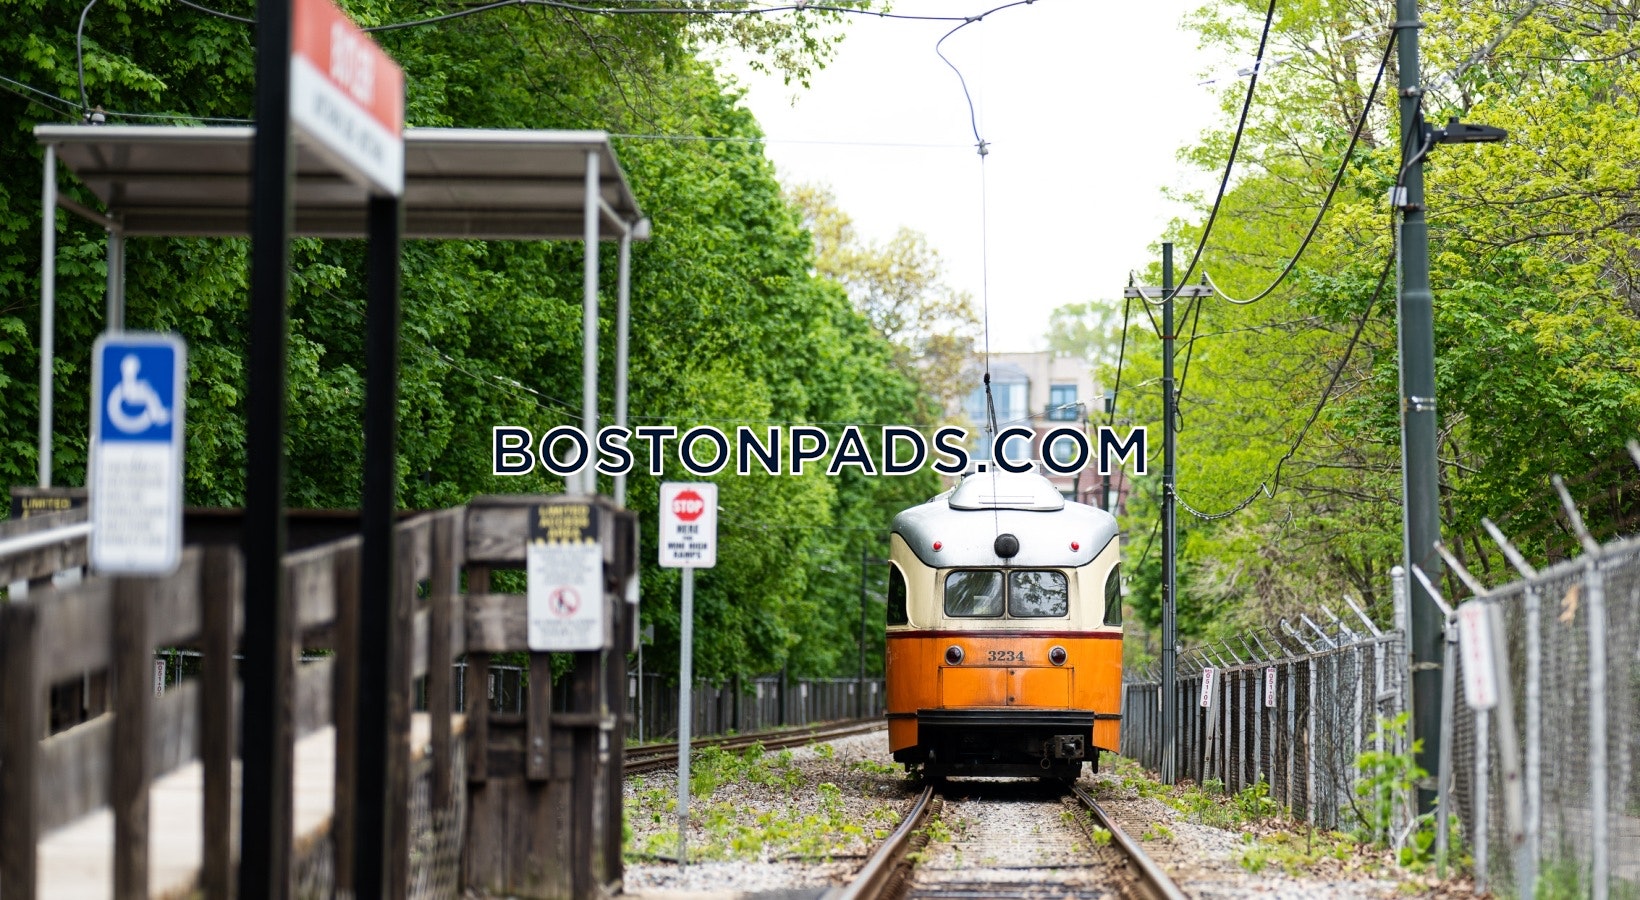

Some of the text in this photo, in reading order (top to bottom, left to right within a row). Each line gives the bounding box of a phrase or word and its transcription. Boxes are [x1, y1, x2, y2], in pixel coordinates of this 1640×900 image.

[22, 498, 71, 509] LIMITED
[673, 500, 704, 514] STOP
[677, 525, 699, 534] HERE
[988, 650, 1025, 662] 3234
